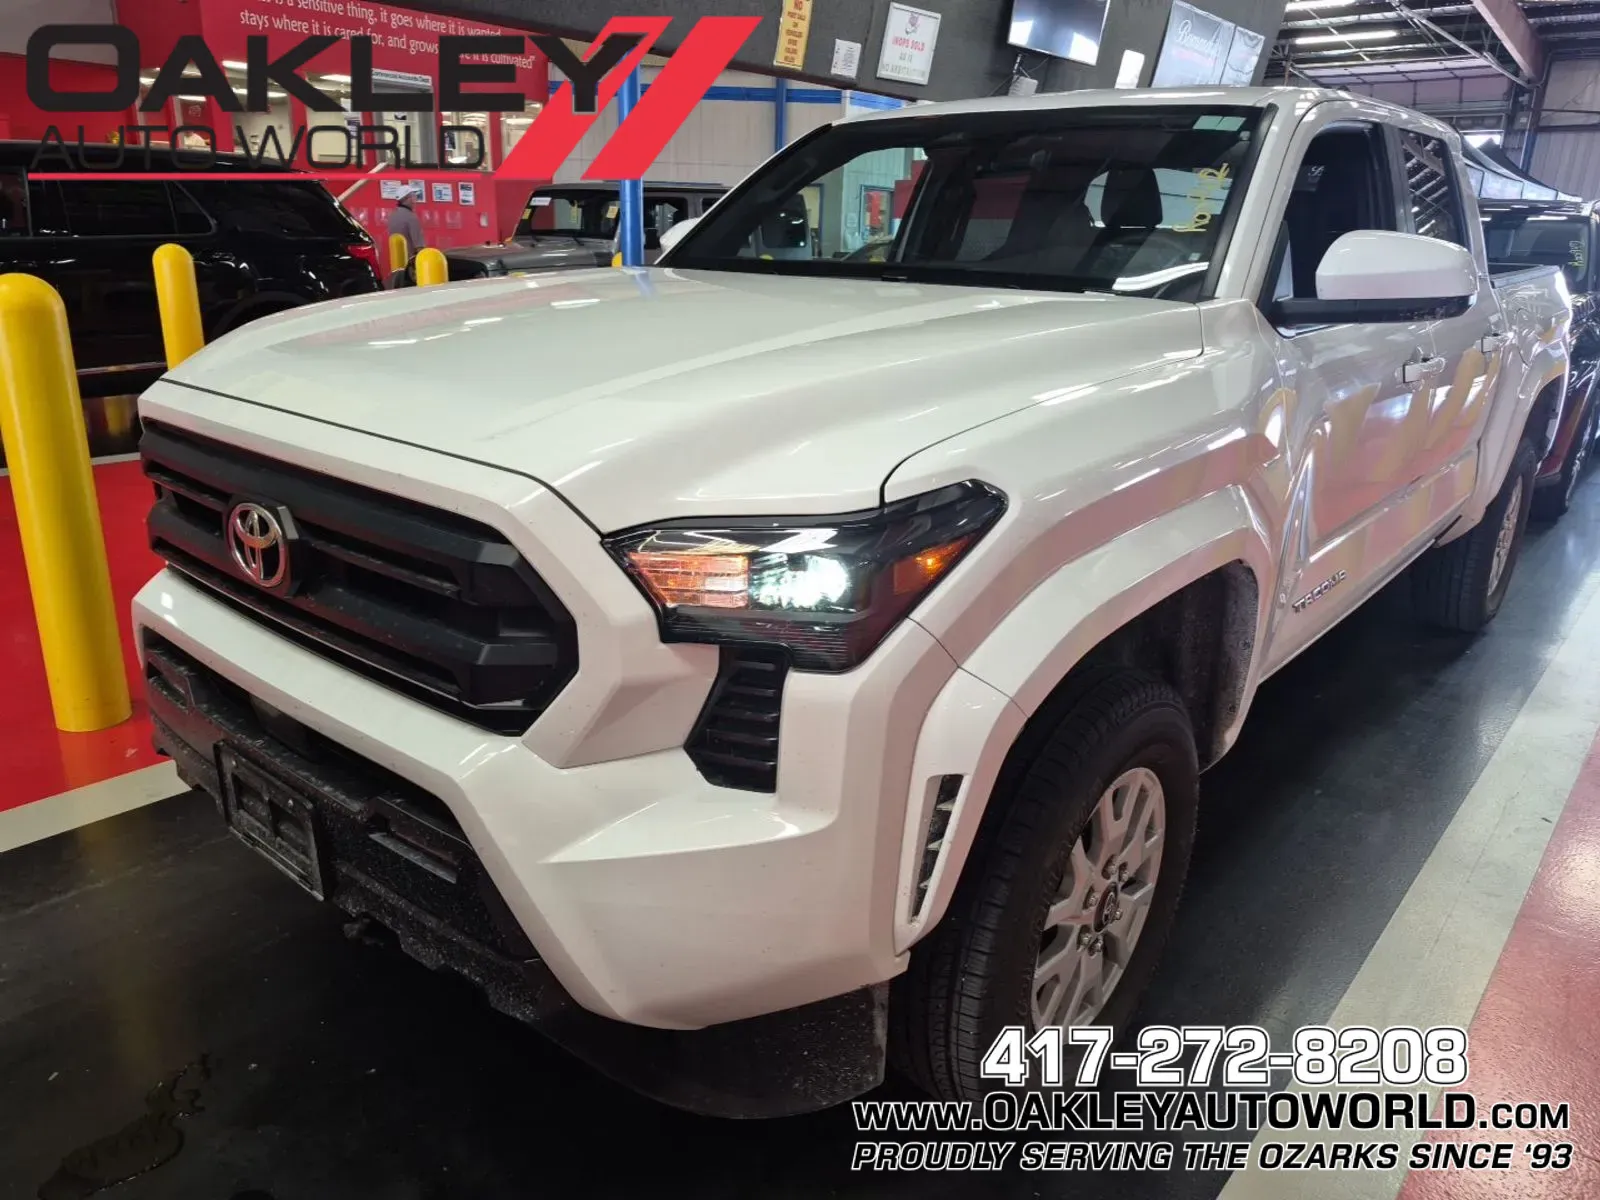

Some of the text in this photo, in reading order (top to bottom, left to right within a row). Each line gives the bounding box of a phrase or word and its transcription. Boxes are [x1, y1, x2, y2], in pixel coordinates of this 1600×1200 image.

[240, 10, 269, 30] stays
[272, 15, 309, 33] where
[311, 19, 321, 36] it
[323, 22, 331, 37] is
[387, 34, 406, 49] and
[409, 39, 439, 55] grows
[298, 0, 344, 15] sensitive
[347, 3, 378, 25] thing,
[380, 8, 388, 23] it
[390, 13, 413, 29] goes
[416, 16, 446, 33] where
[449, 20, 456, 35] it
[458, 22, 465, 36] is
